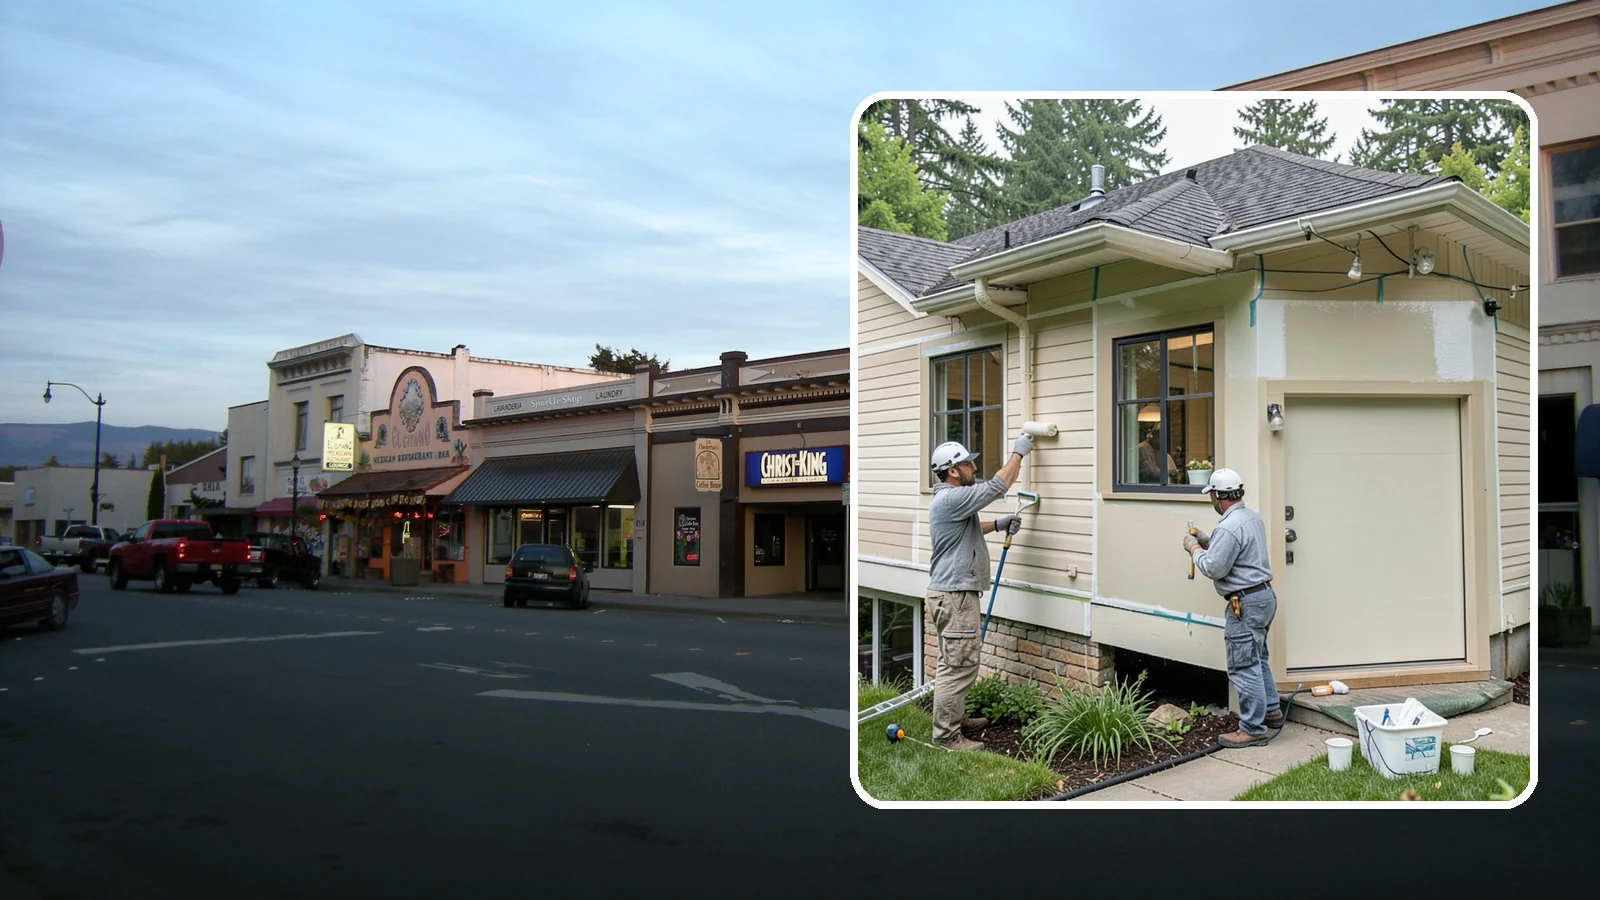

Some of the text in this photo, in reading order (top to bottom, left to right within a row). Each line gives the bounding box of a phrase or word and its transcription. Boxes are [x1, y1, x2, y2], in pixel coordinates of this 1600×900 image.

[530, 394, 583, 409] Sparkle Shop
[595, 389, 624, 400] LAUNDRY
[493, 402, 523, 413] LAVANDERIA
[373, 454, 396, 464] MEXICAN
[397, 451, 434, 462] RESTAURANT
[438, 450, 450, 459] BAR
[761, 450, 827, 478] CHRIST KING
